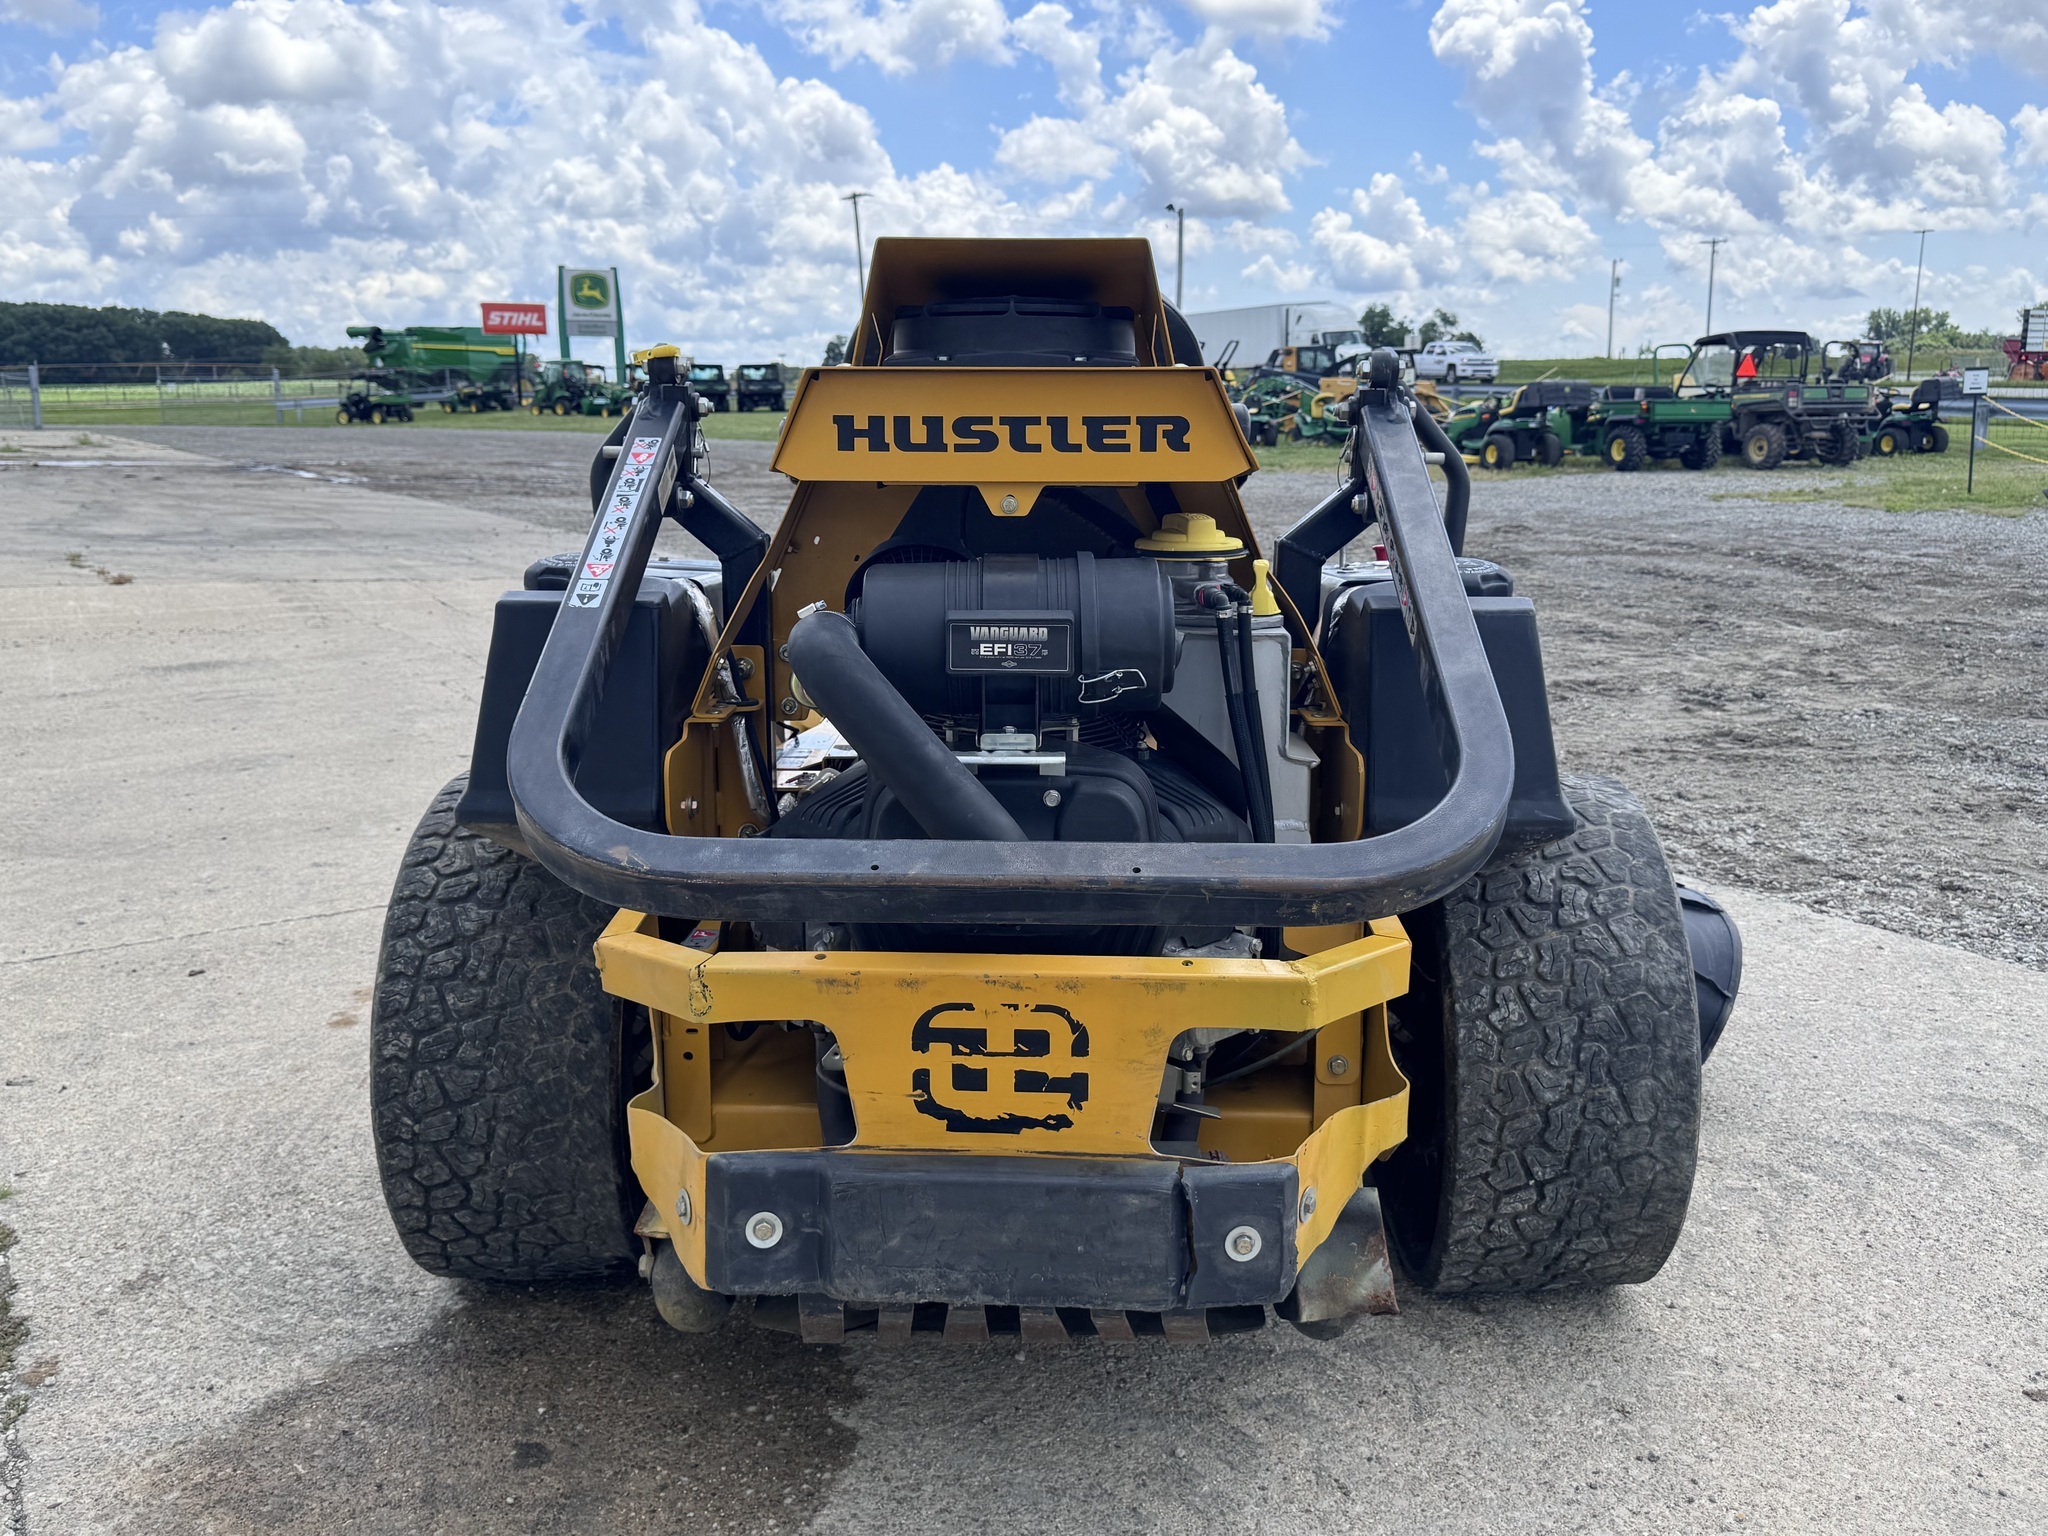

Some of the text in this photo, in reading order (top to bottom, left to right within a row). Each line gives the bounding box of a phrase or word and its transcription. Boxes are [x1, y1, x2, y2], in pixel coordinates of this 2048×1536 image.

[488, 311, 543, 326] STIHL
[832, 414, 1191, 452] HUSTLER
[970, 626, 1048, 642] VANGUARD
